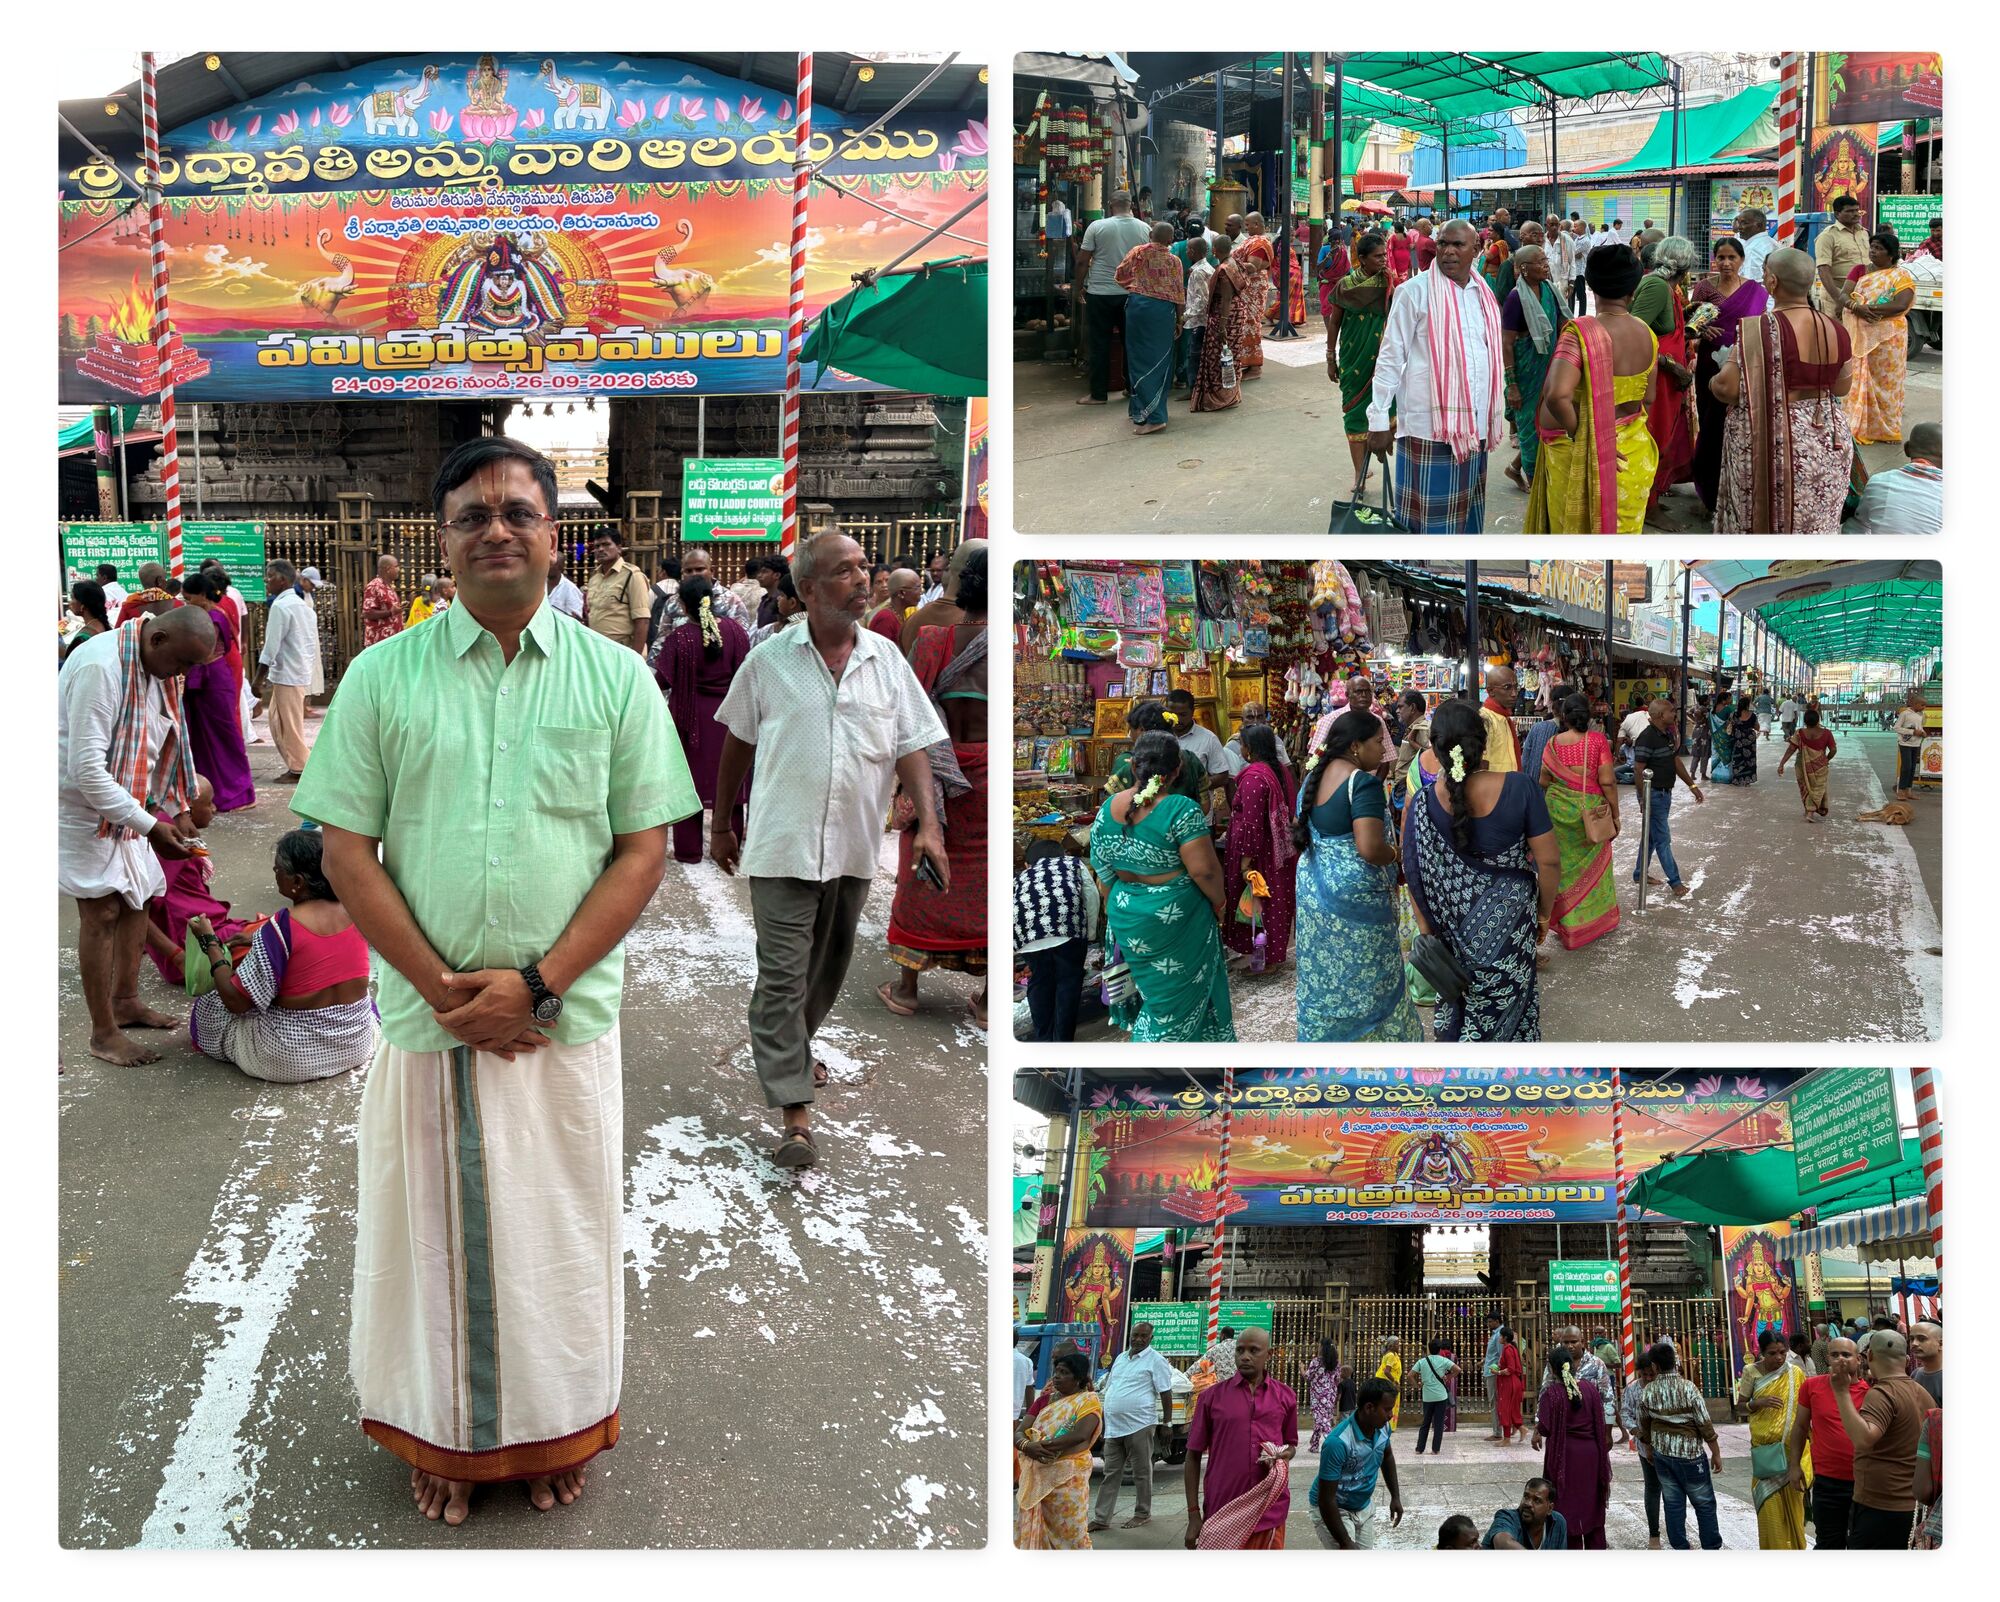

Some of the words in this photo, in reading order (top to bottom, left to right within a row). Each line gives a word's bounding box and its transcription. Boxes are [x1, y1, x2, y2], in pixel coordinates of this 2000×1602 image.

[639, 124, 938, 168] ఆలయము
[391, 194, 438, 208] తిరుమల
[440, 193, 483, 207] తిరుపతి
[572, 190, 614, 204] తిరుపతి
[346, 216, 360, 238] శ్రీ
[364, 218, 422, 237] పద్మావతి
[426, 218, 490, 236] అమ్మవారి
[494, 216, 559, 232] ఆలయం,
[563, 214, 658, 229] తిరుచానూరు
[256, 322, 782, 372] పవిత్రోత్సవములు
[333, 377, 458, 391] 24-09-2026
[463, 374, 510, 390] నుండి
[516, 374, 645, 388] 26-09-2026
[648, 372, 696, 388] వరకు
[688, 498, 706, 509] WAY
[708, 498, 718, 509] TO
[720, 498, 746, 509] LADDU
[68, 548, 86, 557] FREE
[88, 548, 110, 557] FIRST
[112, 548, 126, 556] AID
[128, 548, 158, 556] CENTER
[1515, 1080, 1684, 1100] ఆలయము
[1794, 1123, 1805, 1138] WAY
[1806, 1120, 1812, 1134] TO
[1813, 1112, 1828, 1129] ANNA
[1828, 1094, 1862, 1122] PRASADAM
[1863, 1082, 1890, 1104] CENTER
[1858, 1142, 1868, 1153] का
[1280, 1179, 1605, 1209] పవిత్రోత్సవములు
[1326, 1210, 1408, 1221] 24-09-2026
[1410, 1208, 1440, 1220] నుండి
[1443, 1209, 1522, 1220] 26-09-2026
[1525, 1208, 1555, 1219] వరకు
